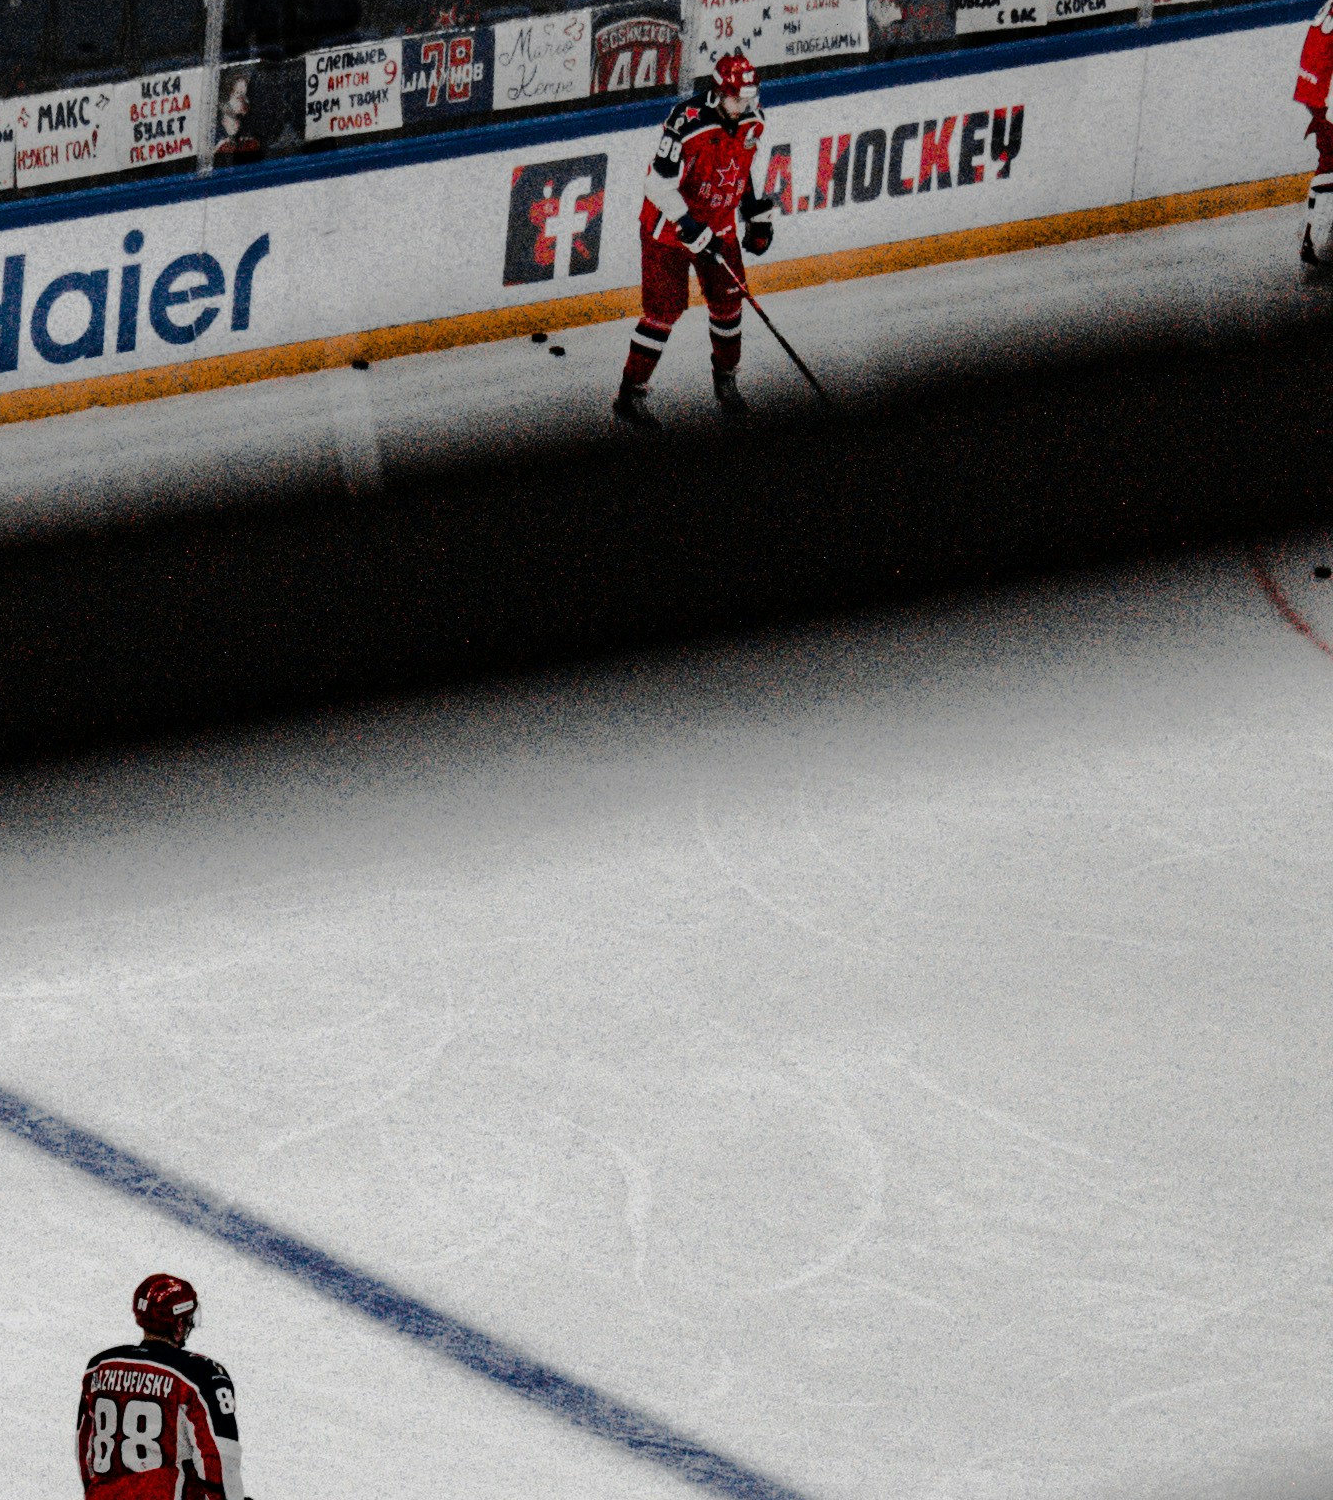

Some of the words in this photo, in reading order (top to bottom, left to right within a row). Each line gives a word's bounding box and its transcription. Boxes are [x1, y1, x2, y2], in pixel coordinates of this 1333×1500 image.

[715, 16, 734, 40] 98
[1010, 7, 1037, 24] ВАС
[785, 33, 862, 56] НЕПОБЕДИМЫ
[326, 71, 369, 92] АНТОН
[420, 36, 474, 107] 78
[607, 49, 658, 92] 44
[141, 76, 181, 99] ЦСКА
[130, 94, 191, 122] ВСЕГДА
[133, 116, 187, 143] БУДЕТ
[17, 144, 60, 171] НУЖЕН
[130, 137, 193, 164] ПЕРВЫМ
[657, 135, 683, 164] 98
[93, 1397, 164, 1473] 88
